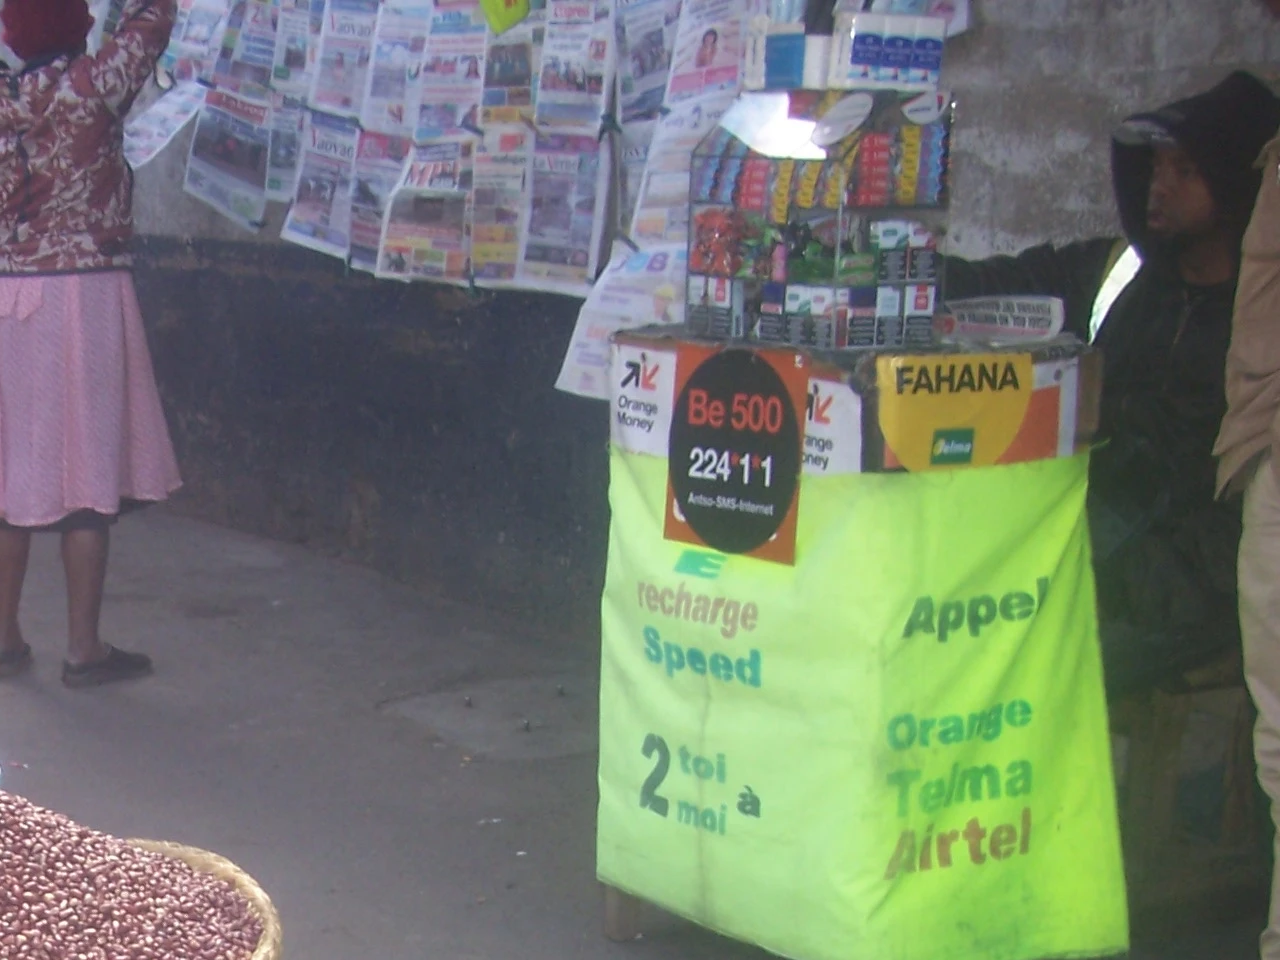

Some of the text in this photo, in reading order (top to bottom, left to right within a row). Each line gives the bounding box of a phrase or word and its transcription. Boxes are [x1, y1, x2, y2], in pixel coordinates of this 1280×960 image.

[895, 362, 1020, 395] FAHANA
[617, 411, 655, 434] Money
[618, 395, 658, 416] Orange
[687, 389, 783, 433] Be 500
[802, 453, 829, 471] oney
[805, 435, 834, 452] ange
[637, 580, 759, 640] recharge
[902, 576, 1050, 643] Appel
[642, 624, 762, 688] Speed
[886, 698, 1032, 752] Orange
[639, 732, 670, 818] 2
[678, 744, 726, 784] toi
[886, 759, 1033, 818] Telma
[677, 800, 727, 836] moi
[883, 806, 1032, 881] Airtel
